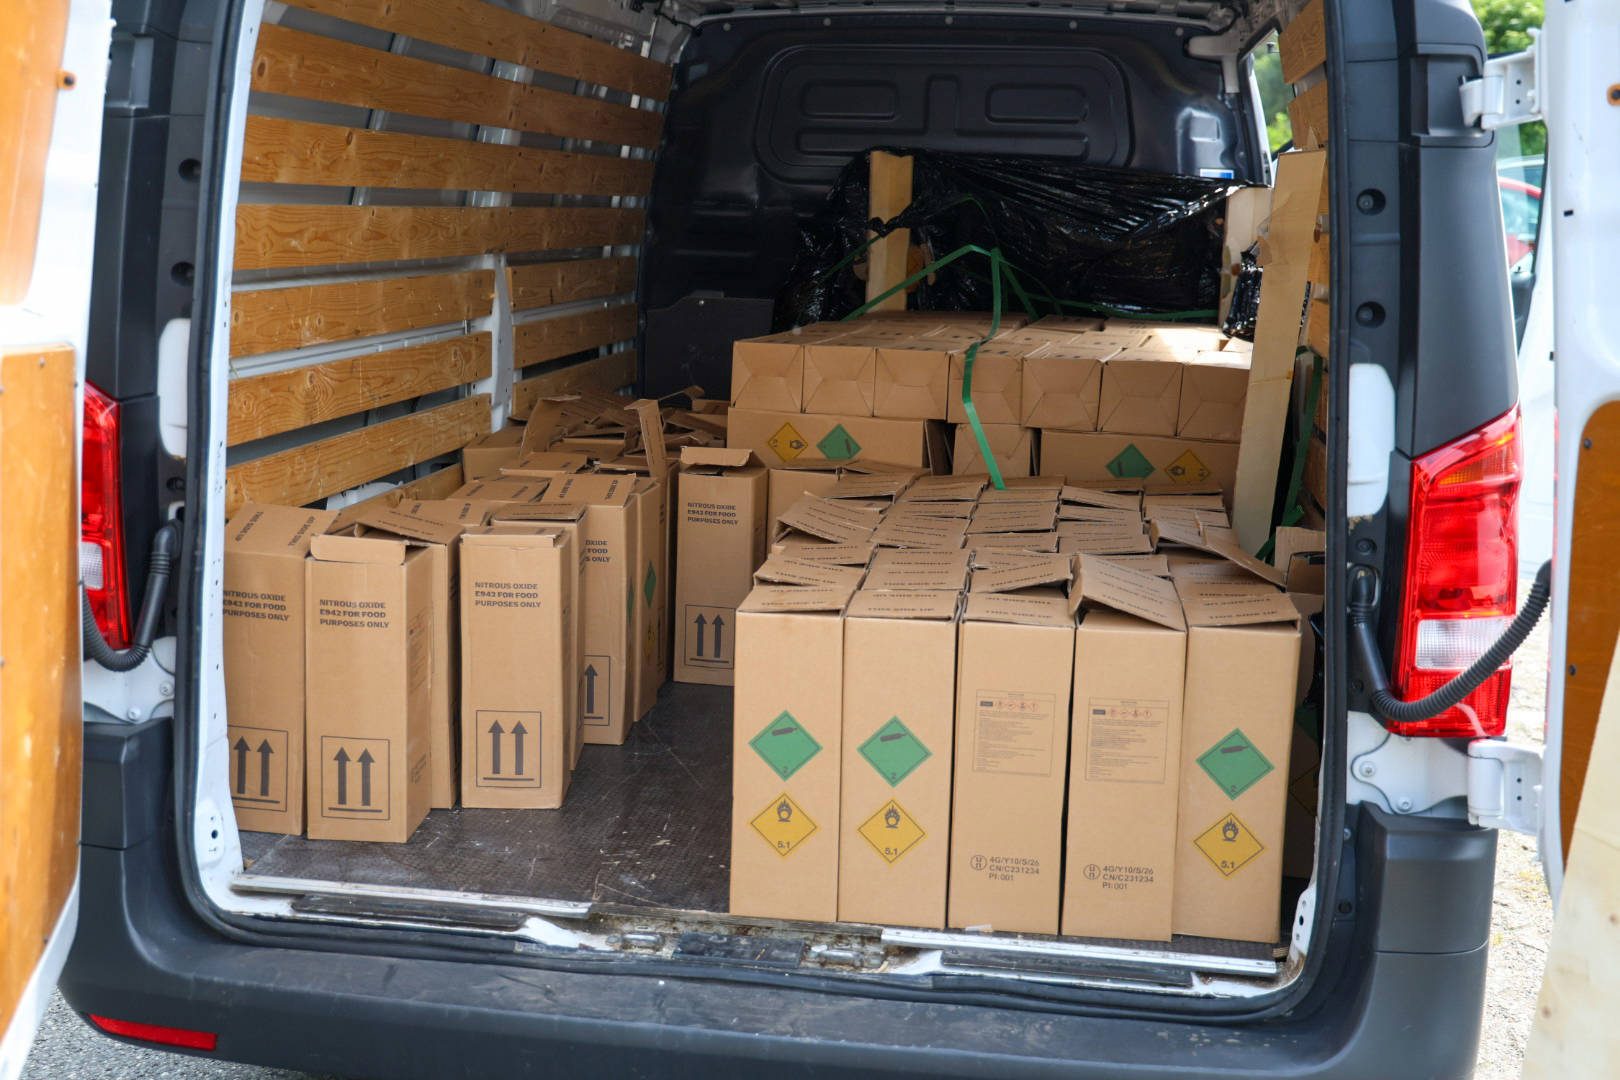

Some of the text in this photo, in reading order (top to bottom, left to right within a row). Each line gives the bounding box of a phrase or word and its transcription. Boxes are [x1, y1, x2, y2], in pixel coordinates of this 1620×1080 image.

[260, 593, 286, 601] OXIDE
[244, 600, 261, 609] FOR
[263, 603, 287, 611] FOOD
[320, 599, 385, 609] NITROUS OXIDE
[267, 613, 289, 621] ONLY
[320, 618, 365, 627] PURPOSES
[777, 841, 791, 849] 5.1
[884, 847, 898, 856] 5.1
[989, 856, 1040, 866] 4G/Y10/S/26
[1220, 860, 1235, 869] 5.1
[989, 864, 1040, 875] CN/C231234
[1102, 865, 1154, 875] 4G/Y10/S/26
[1102, 873, 1154, 883] CN/C231234
